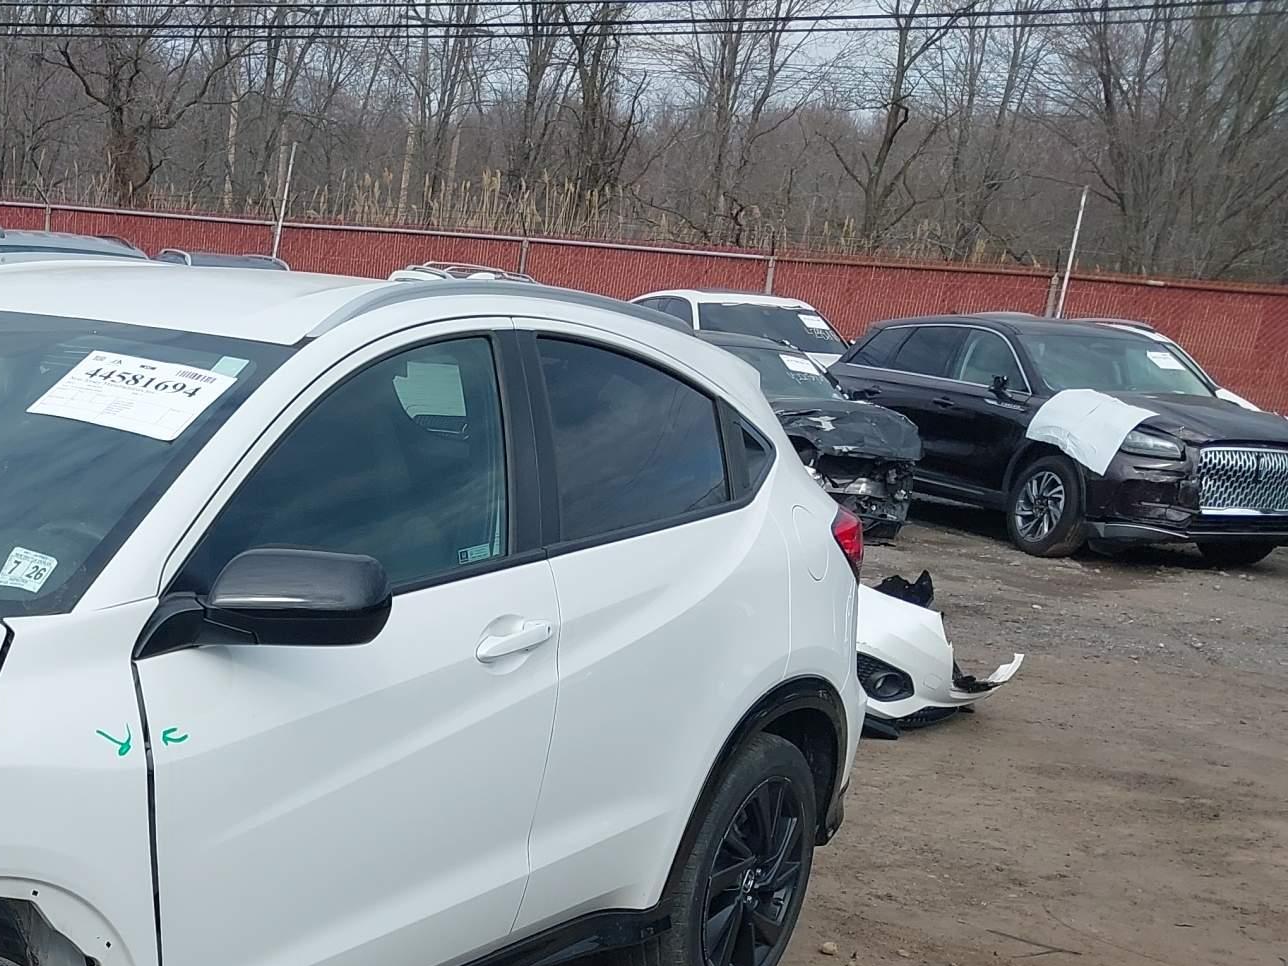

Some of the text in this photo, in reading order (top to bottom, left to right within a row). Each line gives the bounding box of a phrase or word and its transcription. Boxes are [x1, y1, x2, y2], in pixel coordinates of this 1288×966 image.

[85, 367, 202, 398] 44581694
[8, 559, 47, 581] 7 26
